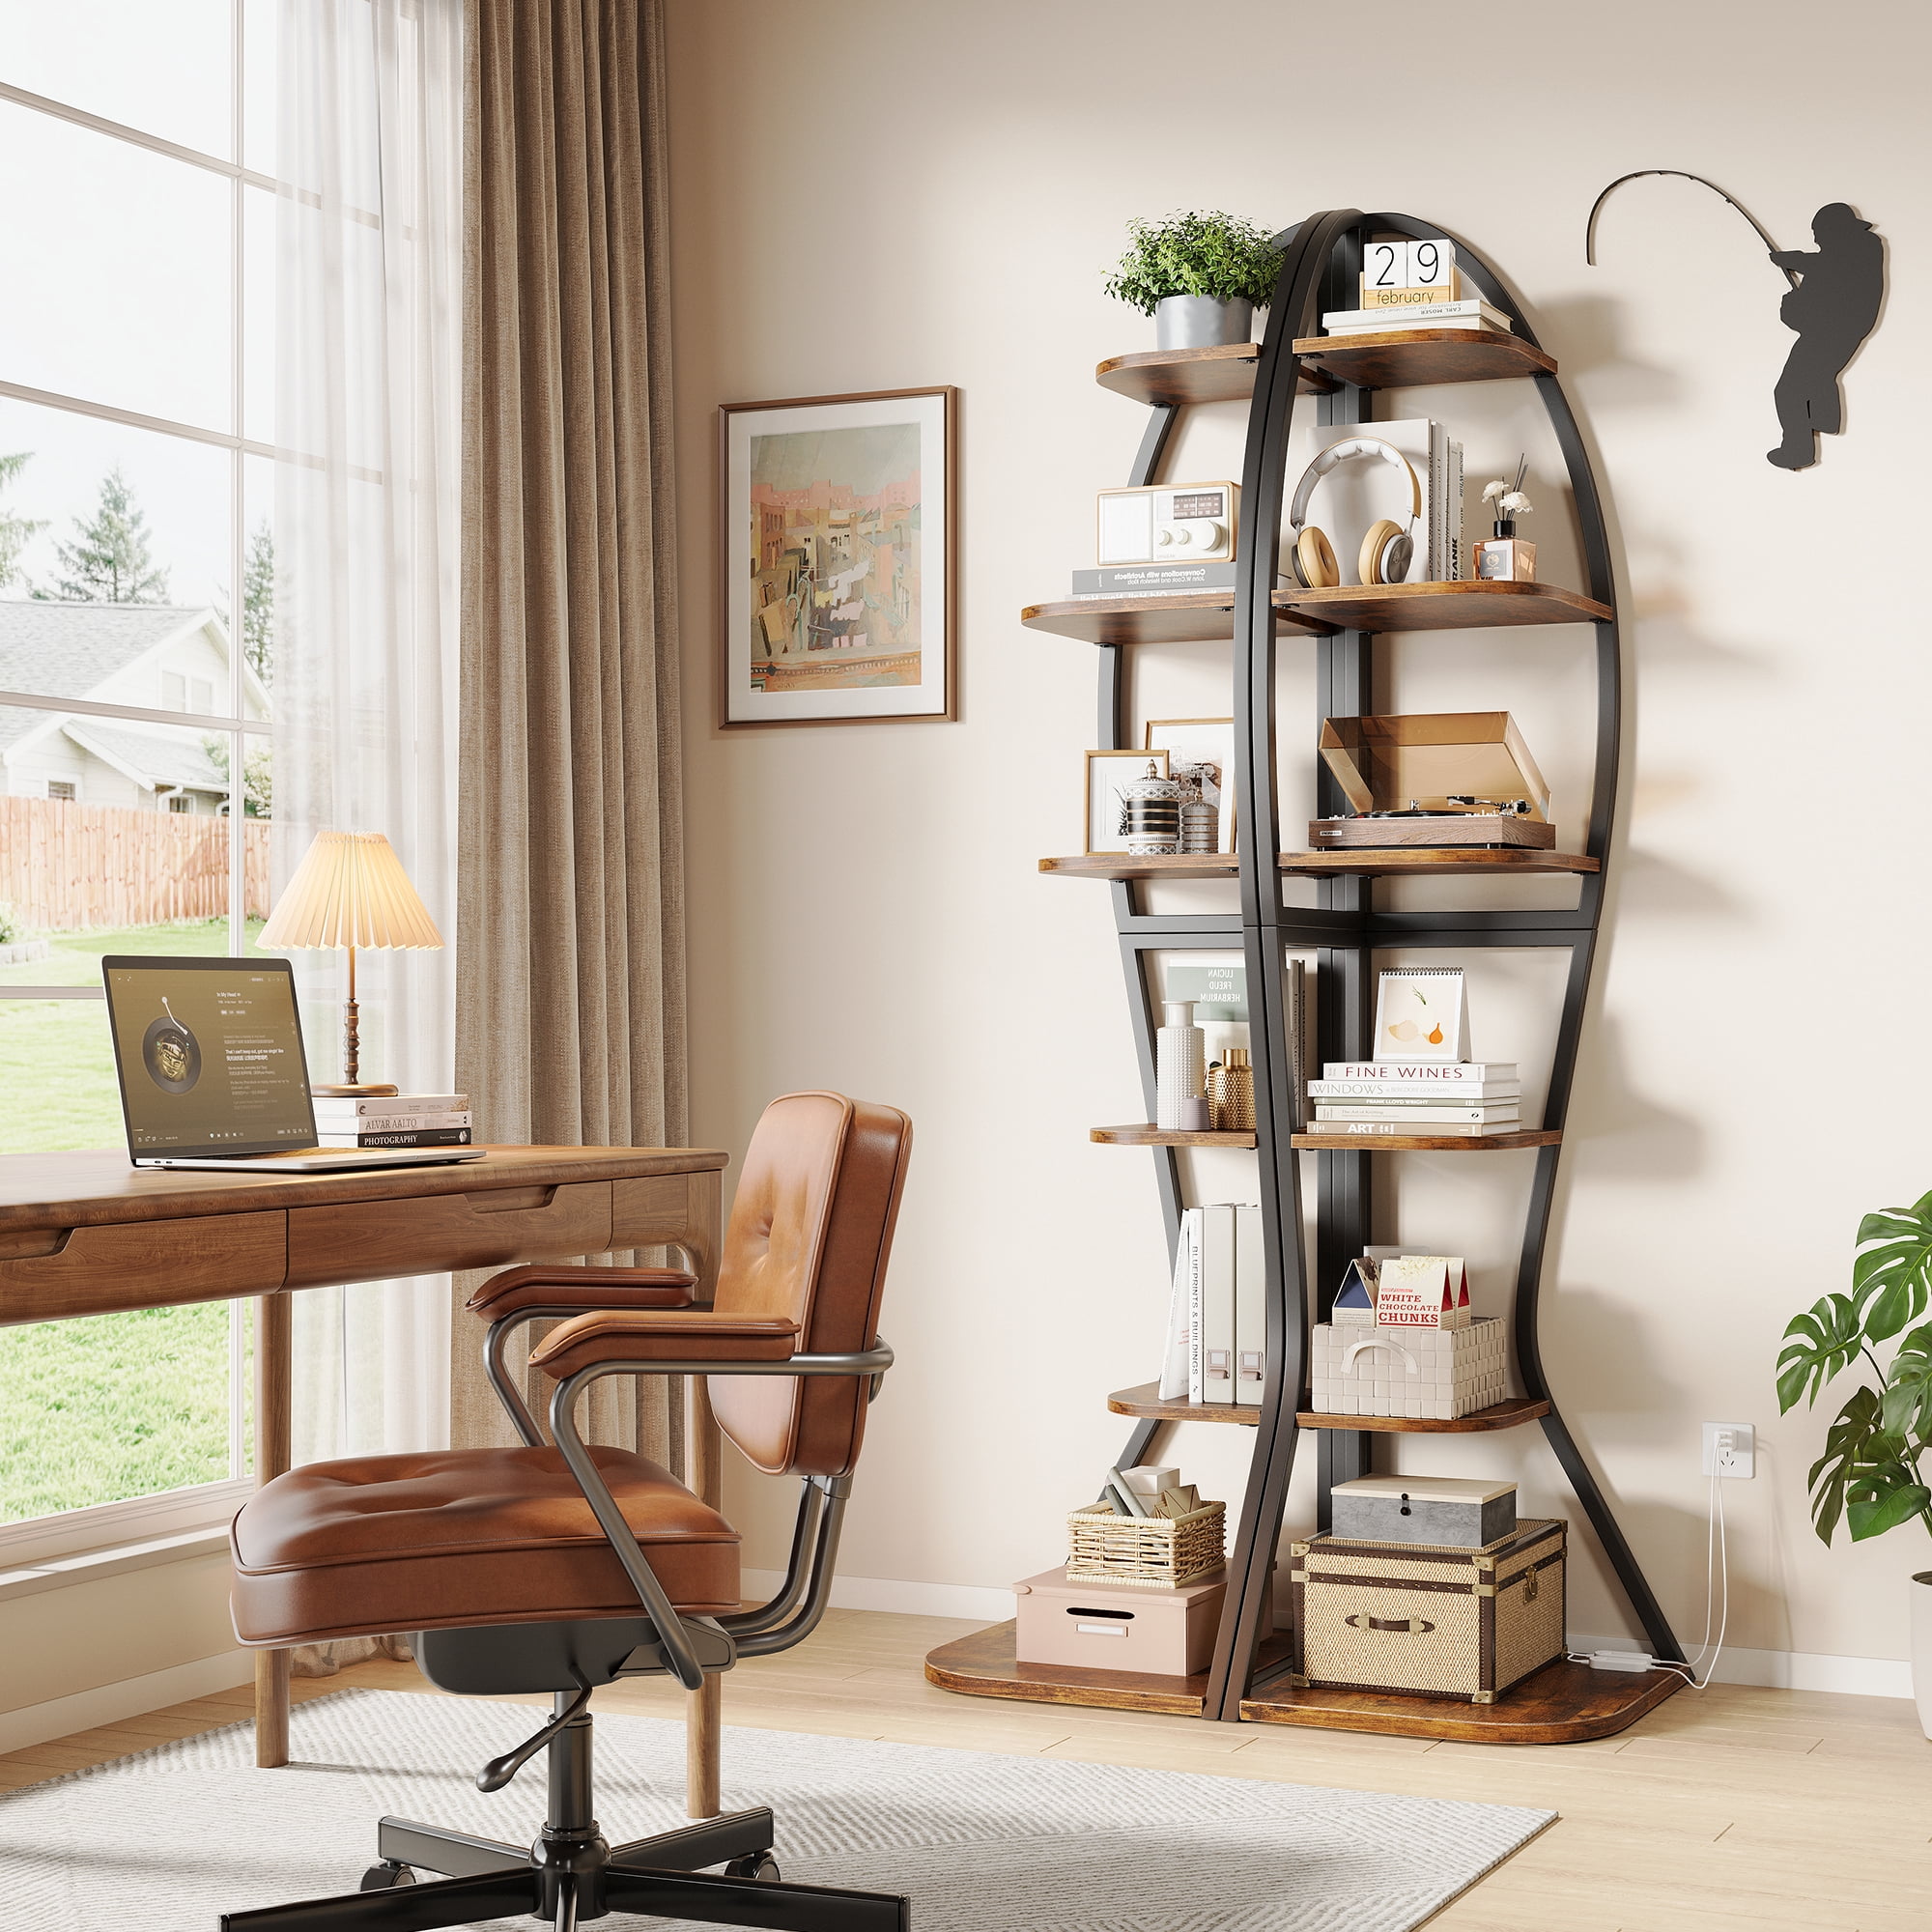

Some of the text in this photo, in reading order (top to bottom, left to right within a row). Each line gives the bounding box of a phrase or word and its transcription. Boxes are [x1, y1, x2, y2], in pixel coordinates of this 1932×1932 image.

[1377, 290, 1435, 305] february
[1345, 1066, 1388, 1078] FINE
[1398, 1066, 1463, 1079] WINES
[1313, 1084, 1383, 1095] WINDOWS
[365, 1119, 417, 1130] ALVAR AALTO
[1347, 1124, 1376, 1133] ART
[364, 1135, 417, 1146] PHOTOGRAPHY
[1380, 1294, 1422, 1303] WHITE
[1378, 1312, 1438, 1323] CHUNKS
